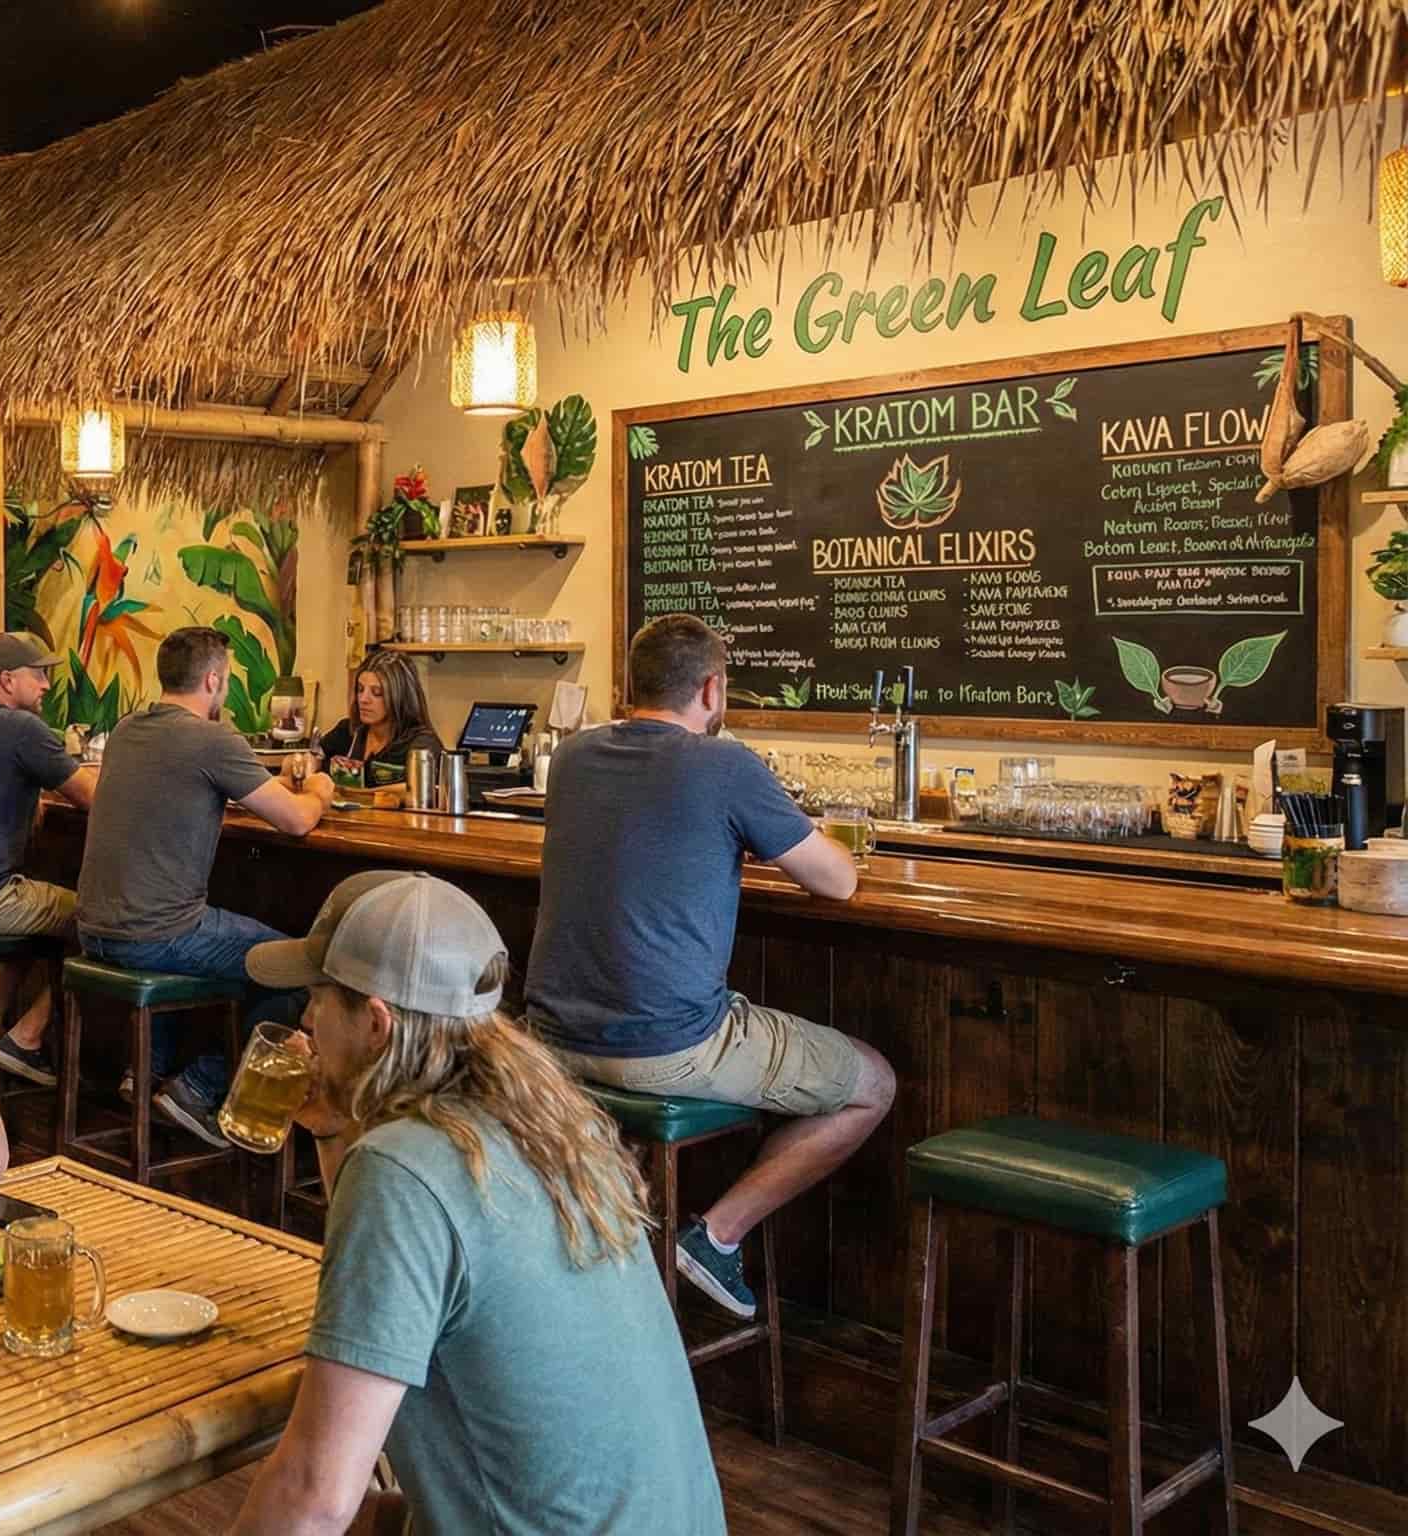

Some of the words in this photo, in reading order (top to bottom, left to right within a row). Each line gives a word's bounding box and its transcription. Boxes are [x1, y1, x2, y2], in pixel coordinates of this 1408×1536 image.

[672, 284, 773, 373] The
[793, 271, 998, 355] Green
[1020, 196, 1225, 323] Leaf
[835, 395, 956, 443] KRATOM
[971, 386, 1040, 430] BAR
[1101, 415, 1174, 454] KAVA
[1185, 404, 1270, 448] FLOW
[644, 458, 722, 493] KRATOM
[730, 453, 771, 483] TEA
[691, 495, 714, 510] TEA
[688, 512, 711, 526] TEA
[690, 527, 713, 541] TEA
[812, 533, 931, 569] BOTANICAL
[939, 528, 1036, 564] ELIXIRS
[695, 558, 717, 573] TEA
[690, 581, 712, 595] TEA
[698, 596, 720, 610] TEA
[959, 683, 1011, 704] Kratom
